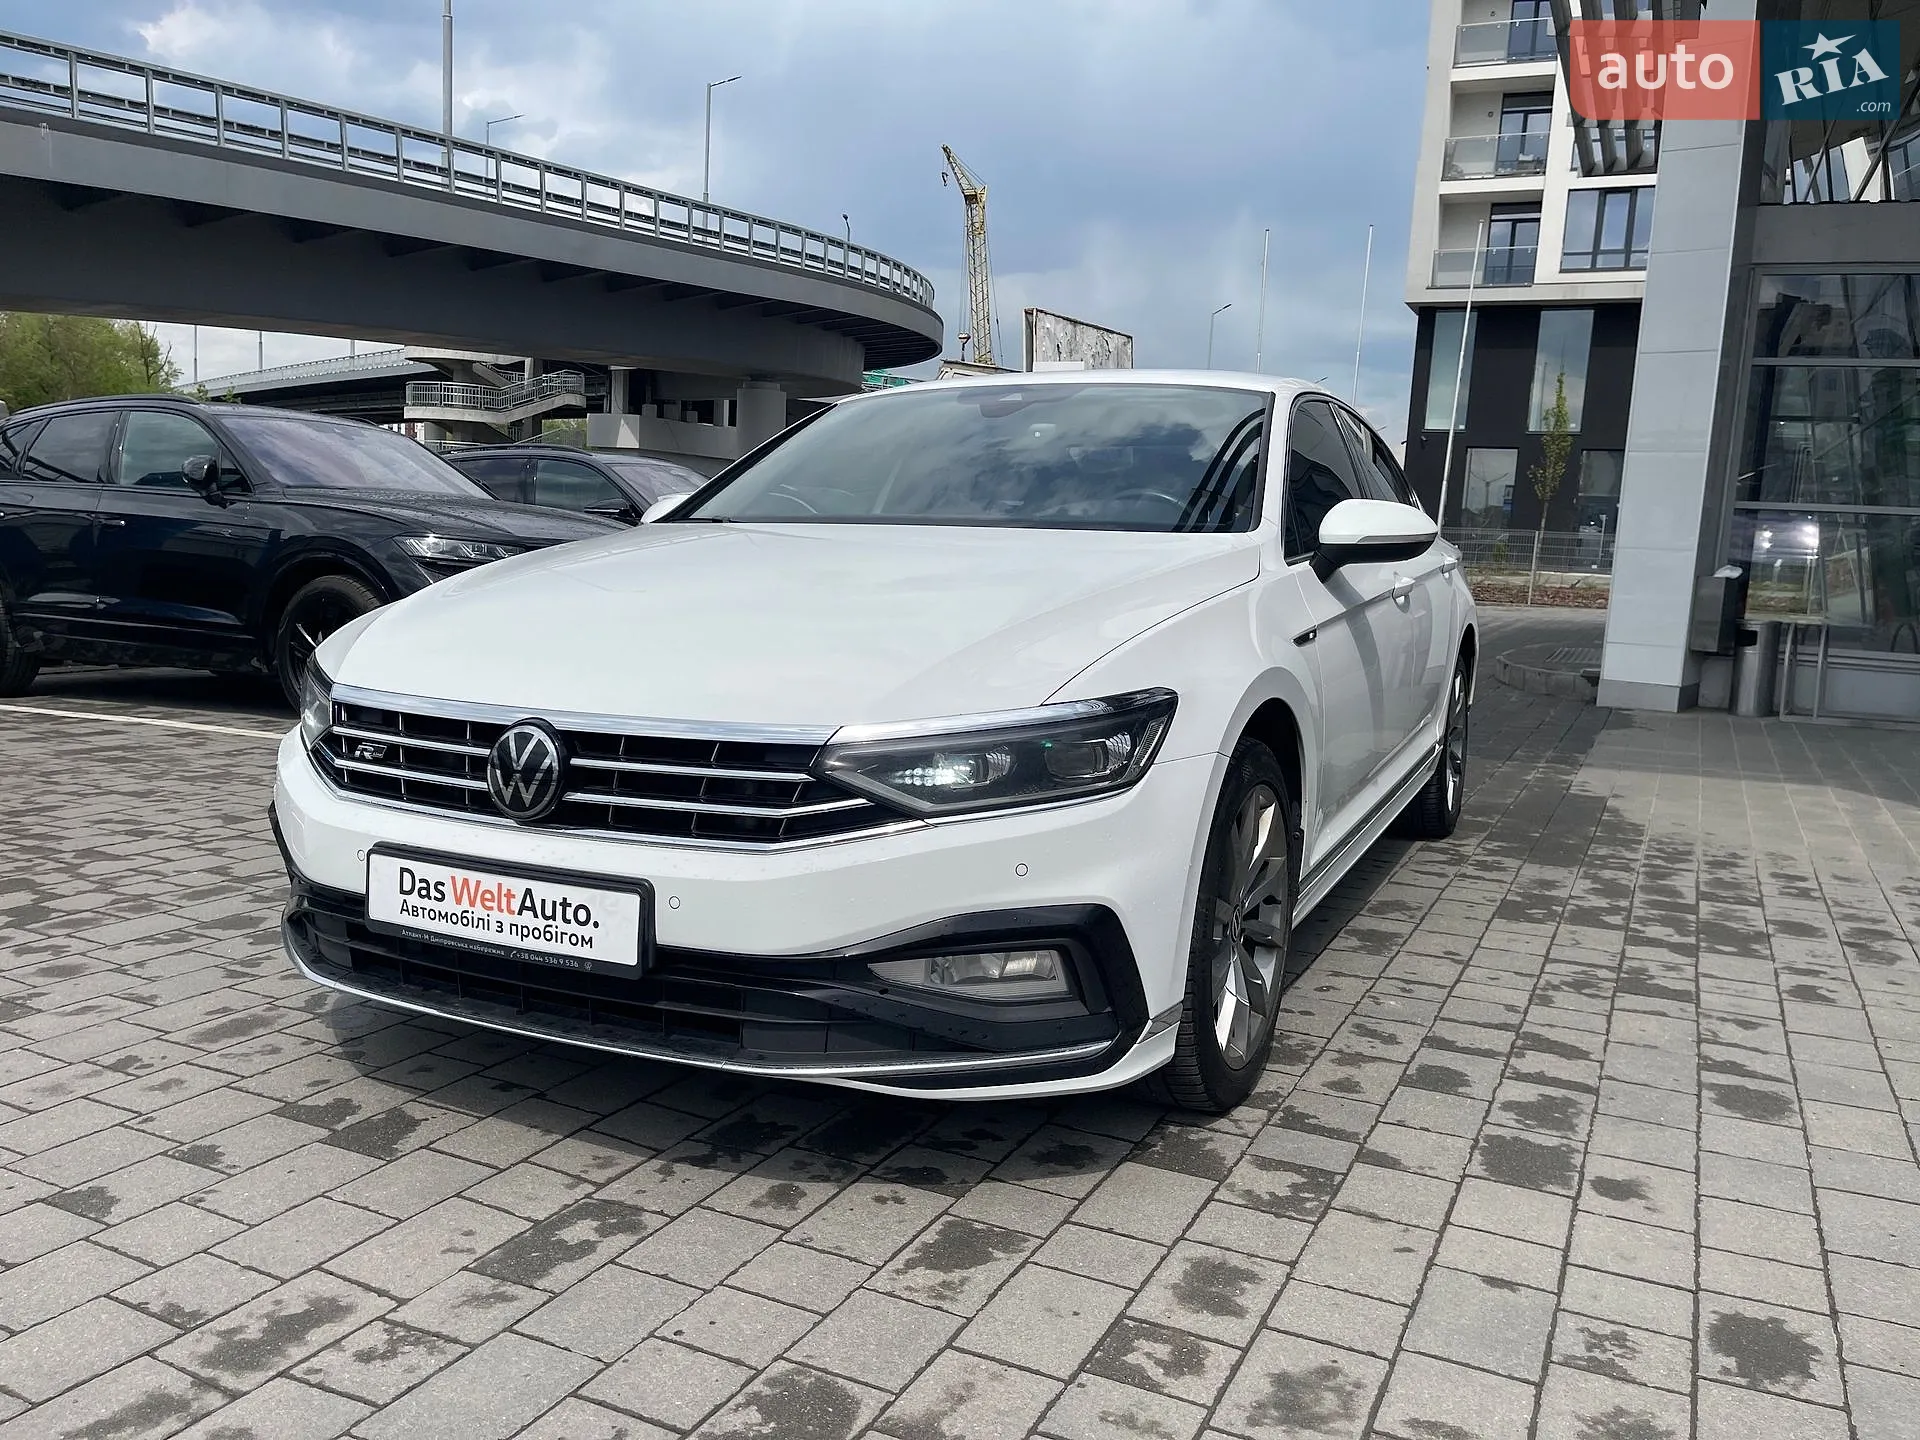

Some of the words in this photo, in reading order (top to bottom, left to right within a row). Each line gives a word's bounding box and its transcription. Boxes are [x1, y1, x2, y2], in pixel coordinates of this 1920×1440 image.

[400, 898, 491, 932] Автомобілі
[495, 923, 504, 933] з
[509, 922, 593, 950] пробігом
[530, 954, 543, 962] 044
